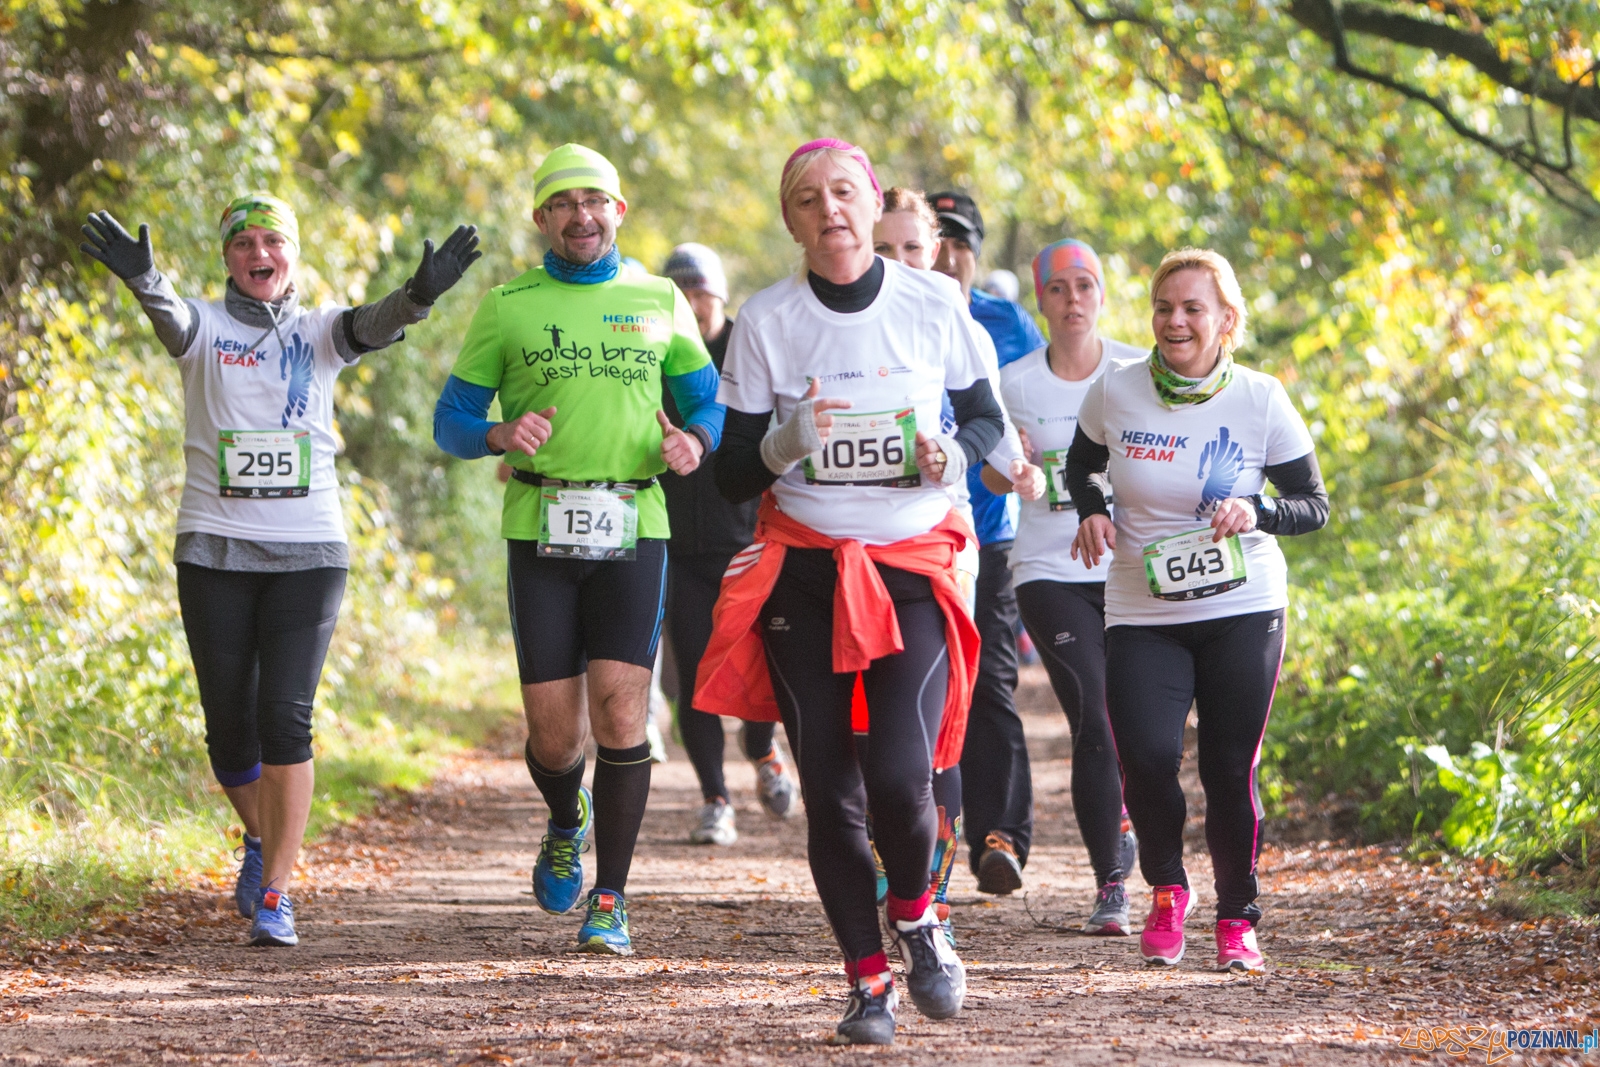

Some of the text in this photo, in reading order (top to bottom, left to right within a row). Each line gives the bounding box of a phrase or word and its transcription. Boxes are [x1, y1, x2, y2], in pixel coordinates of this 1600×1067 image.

[217, 350, 259, 367] TEAM
[535, 361, 583, 387] jest
[1121, 430, 1189, 449] HERNIK
[823, 435, 903, 469] 1056
[1125, 446, 1175, 462] TEAM
[237, 452, 292, 476] 295
[827, 469, 896, 480] KARIN PARKRUN
[564, 509, 613, 537] 134
[1166, 548, 1224, 582] 643
[1188, 579, 1210, 589] EDYTA
